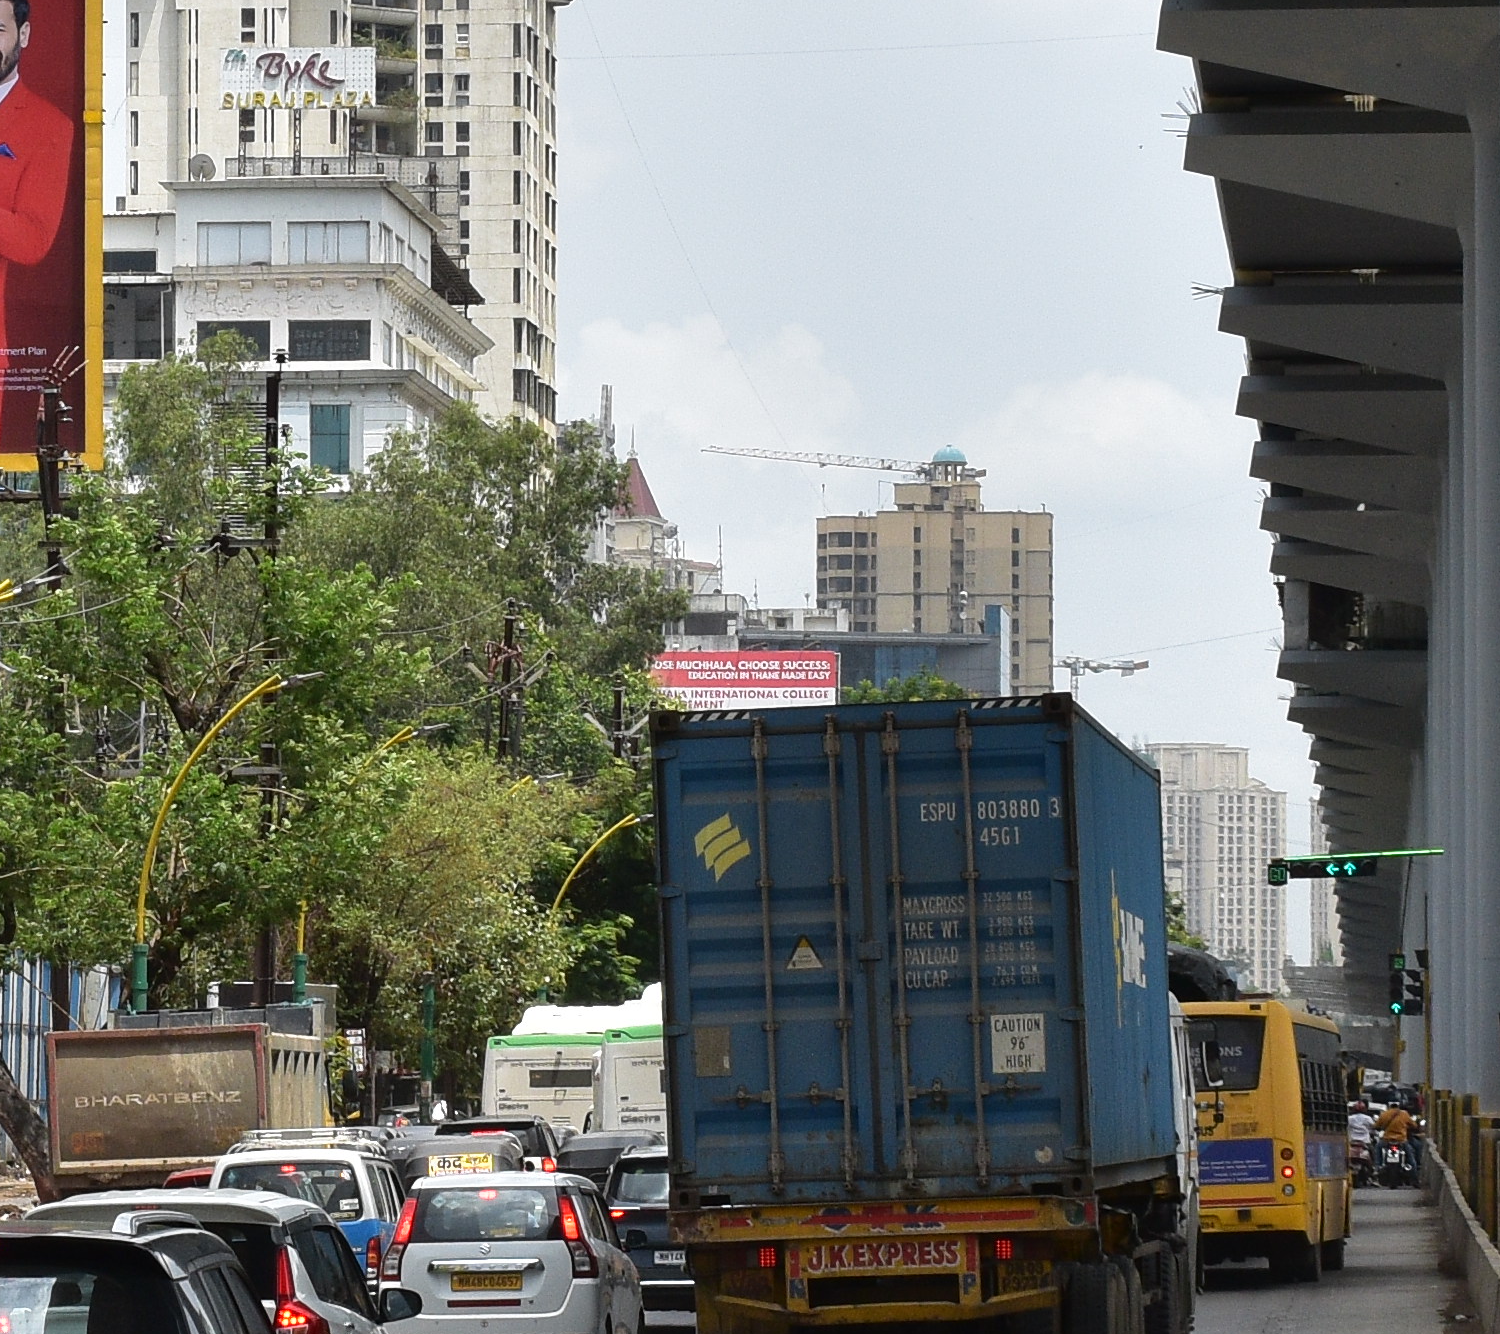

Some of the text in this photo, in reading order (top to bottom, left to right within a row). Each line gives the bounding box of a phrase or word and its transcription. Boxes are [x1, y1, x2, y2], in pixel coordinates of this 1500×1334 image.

[255, 52, 346, 93] Byke
[221, 91, 373, 109] SURAJ PLAZA
[27, 346, 47, 357] Plan
[676, 661, 735, 671] MUCHHALA,
[738, 660, 780, 670] CHOOSE
[783, 660, 831, 670] SUCCESS:
[688, 671, 831, 680] EDUCATION IN THANE MADE EASY
[691, 689, 778, 699] INTERNATIONAL
[783, 689, 829, 699] COLLEGE
[920, 796, 1060, 822] ESPU 803880 3
[979, 826, 1020, 846] 45G1
[904, 921, 934, 940] TARE
[940, 920, 962, 939] WT.
[904, 946, 958, 965] PAYLOAD
[994, 1018, 1041, 1032] CAUTION
[1006, 1054, 1032, 1067] HIGH
[75, 1090, 242, 1108] BHARATBENZ
[807, 1241, 960, 1273] J.K.EXPRESS
